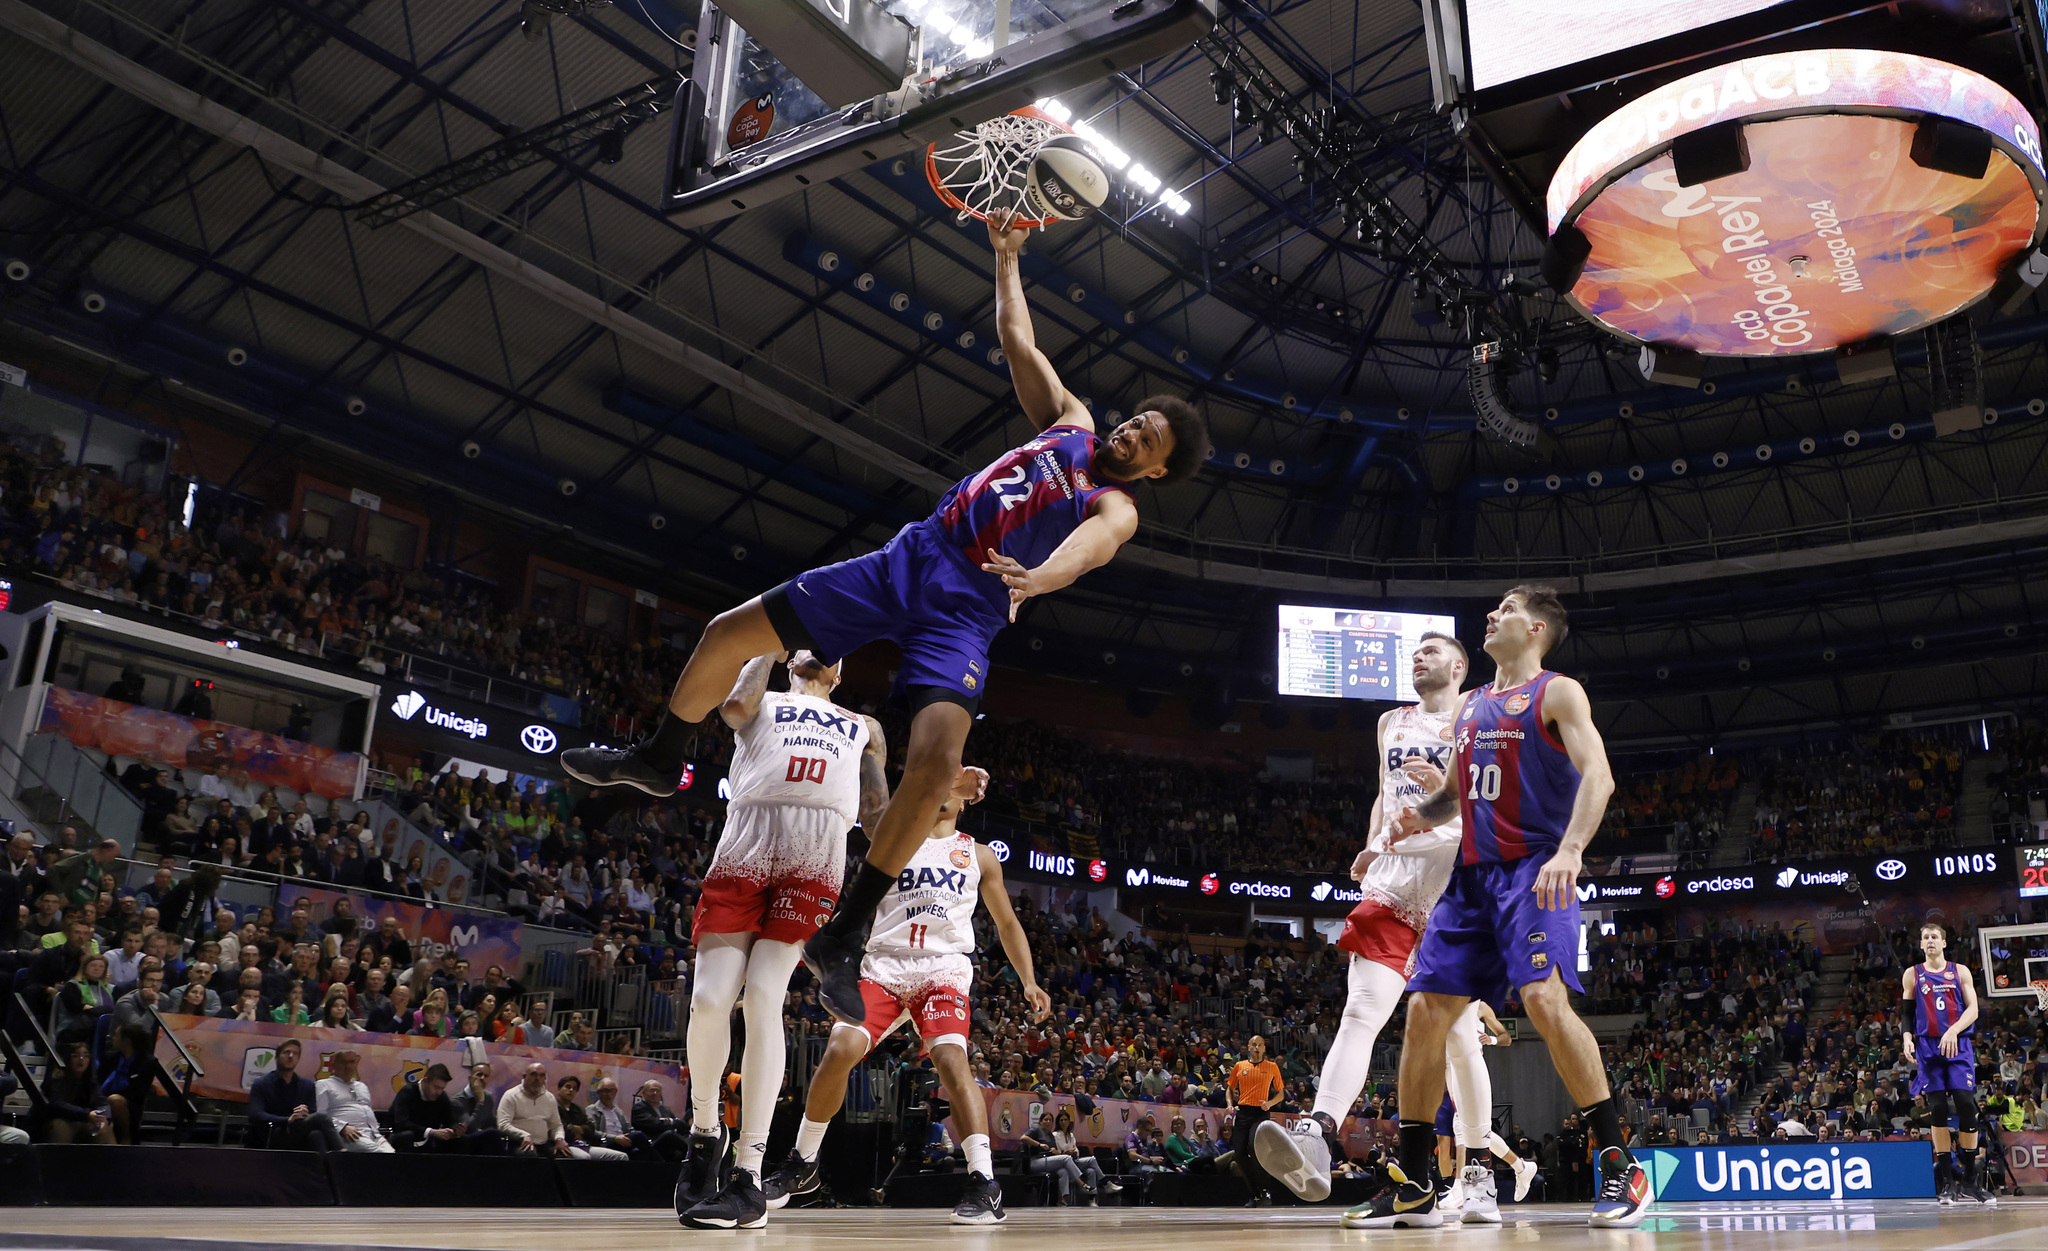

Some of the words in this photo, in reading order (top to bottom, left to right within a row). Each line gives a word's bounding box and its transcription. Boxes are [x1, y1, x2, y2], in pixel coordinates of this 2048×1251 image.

[736, 119, 758, 132] Copa
[744, 127, 760, 137] Rey
[1711, 195, 1769, 253] Rey
[1807, 200, 1842, 237] 2024
[1737, 253, 1777, 285] del
[1754, 284, 1813, 347] Copa
[1721, 309, 1770, 341] acb
[1034, 453, 1057, 490] Sanitària
[1043, 450, 1074, 500] Assistència
[989, 465, 1033, 511] 22
[1343, 614, 1353, 626] 4
[1383, 616, 1392, 628] 7
[1354, 640, 1384, 654] 7:42
[1361, 656, 1376, 667] 1T
[1349, 674, 1358, 686] 0
[1380, 675, 1390, 688] 0
[425, 705, 488, 739] Unicaja
[775, 706, 858, 741] BAXI
[774, 724, 854, 750] CLIMATIZACIÓN
[1475, 728, 1525, 740] Assistència
[783, 736, 839, 759] MANRESA
[1473, 739, 1508, 750] Sanitària
[785, 755, 827, 784] 00
[1468, 763, 1502, 801] 20
[1396, 784, 1428, 799] MANRE
[1935, 853, 1997, 876] IONOS
[898, 867, 966, 895] BAXI
[1152, 875, 1190, 888] Movistar
[1229, 880, 1291, 898] endesa
[1687, 876, 1753, 893] endesa
[898, 890, 961, 905] CLIMATIZACIÓN
[1602, 886, 1642, 897] Movistar
[769, 909, 809, 925] GLOBAL
[1817, 911, 1845, 920] Copa
[909, 922, 927, 949] 11
[1936, 996, 1945, 1010] 6
[923, 1010, 952, 1020] OBAL
[2011, 1145, 2048, 1168] DE
[1695, 1146, 1873, 1199] Unicaja
